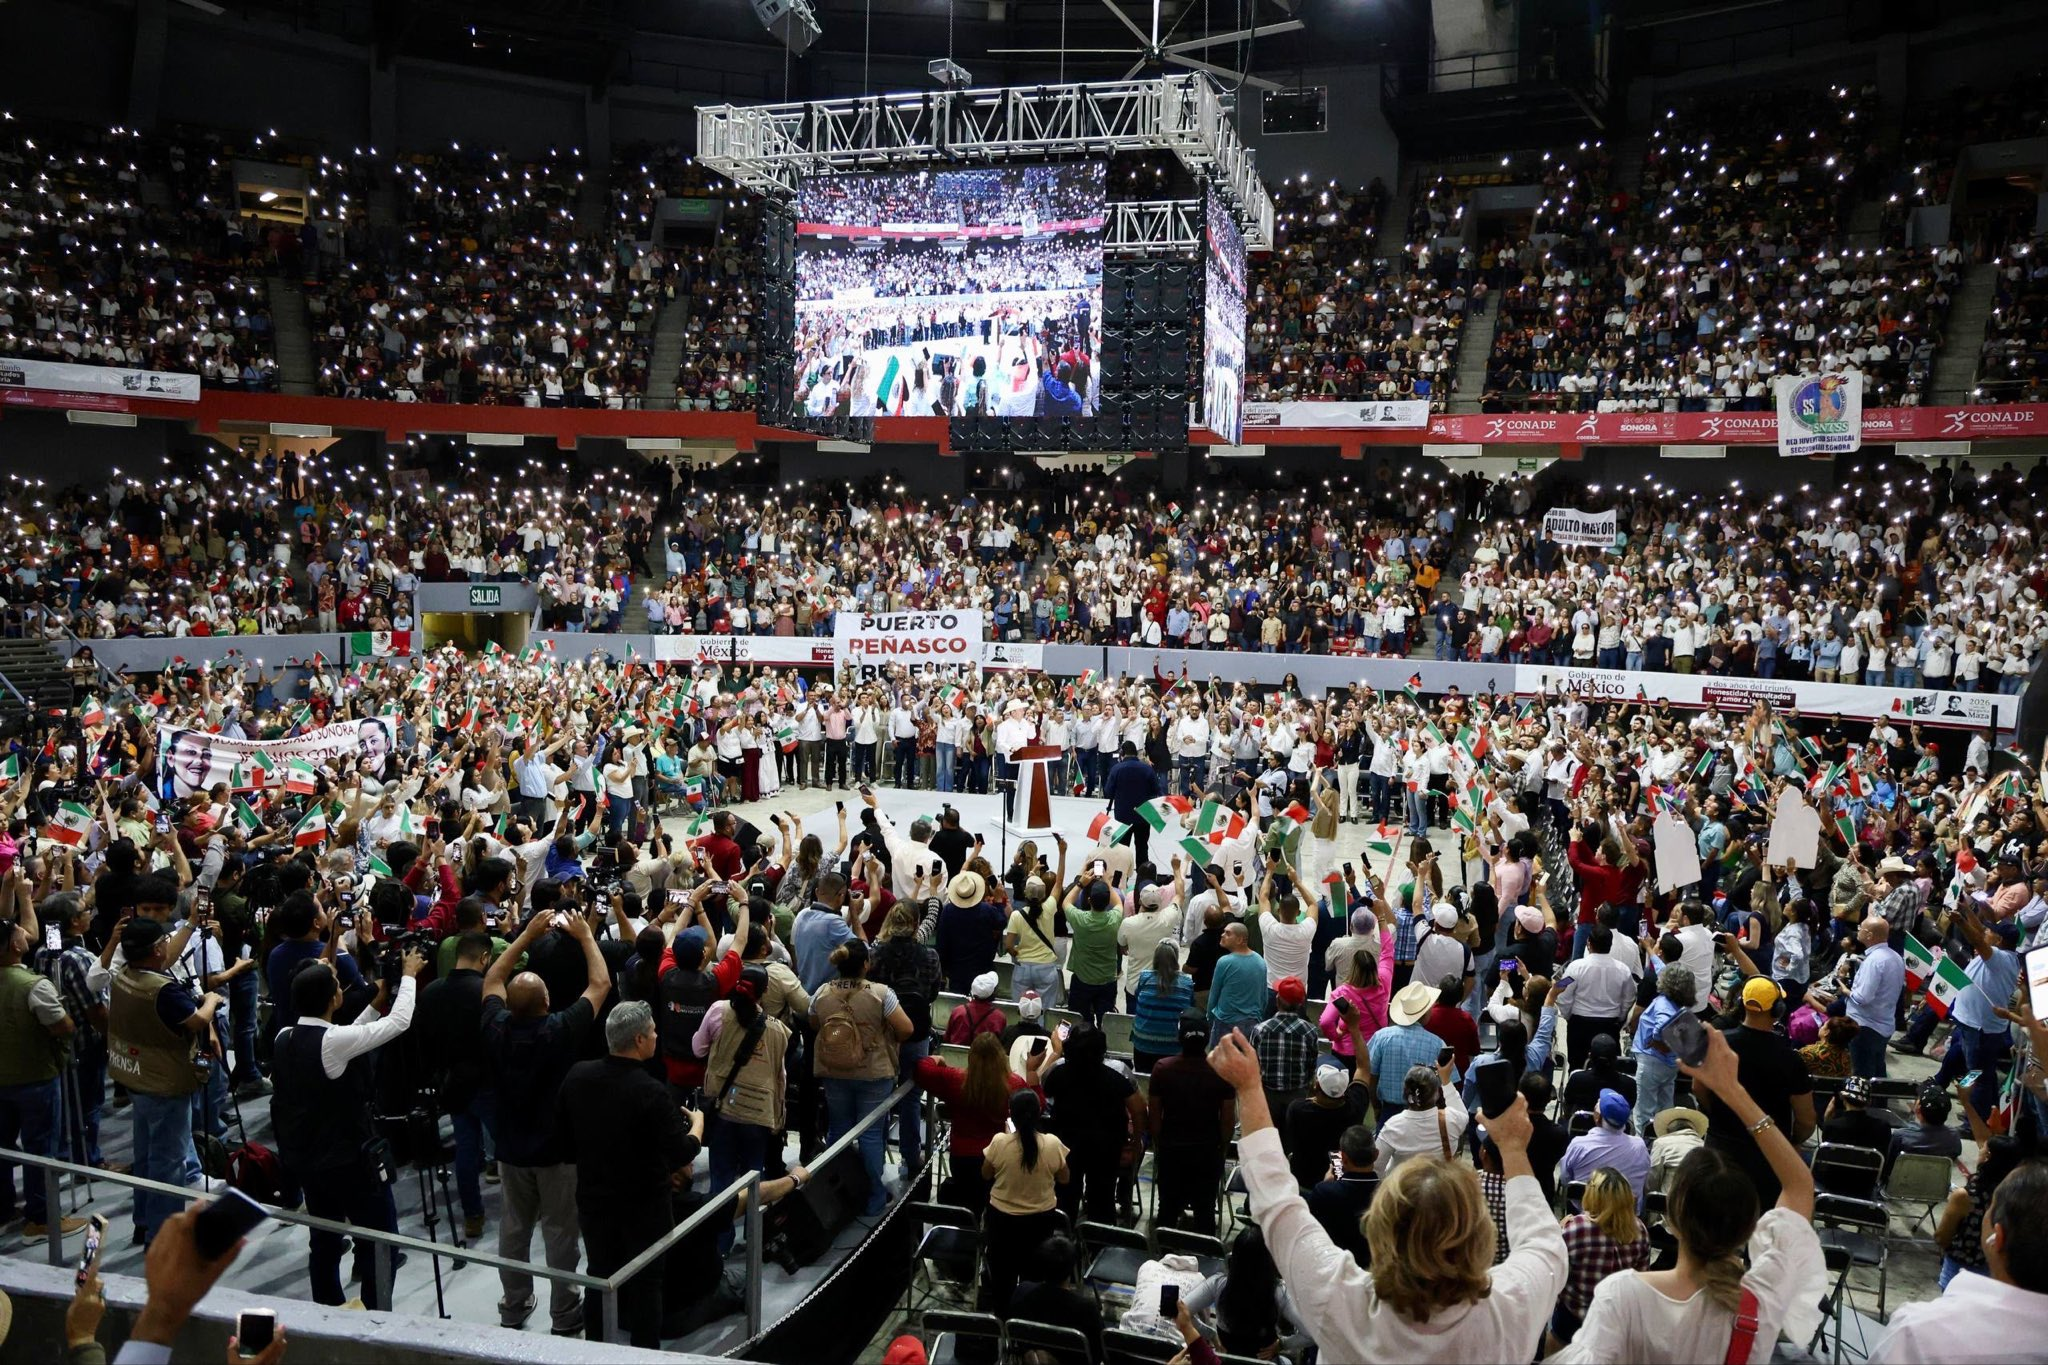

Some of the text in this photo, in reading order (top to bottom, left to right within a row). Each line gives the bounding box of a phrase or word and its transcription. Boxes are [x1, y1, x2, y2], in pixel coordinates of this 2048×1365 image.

[1803, 399, 1815, 416] SS
[1724, 418, 1778, 428] CONADE
[1970, 411, 2034, 423] CONADE
[1507, 420, 1556, 430] CONADE
[1620, 424, 1658, 432] SONORA
[1813, 421, 1849, 434] SNTSS
[1826, 434, 1855, 442] SINDICAL
[1545, 518, 1614, 535] ADULTO MAYOR
[471, 589, 500, 604] SALIDA
[860, 615, 958, 631] PUERTO
[849, 635, 967, 654] PEÑASCO
[700, 645, 748, 658] México
[1568, 671, 1625, 681] Gobierno de
[1568, 679, 1625, 694] México
[1765, 684, 1793, 692] triunfo
[1707, 688, 1791, 700] Honestidad, resultados
[1970, 698, 1990, 706] 2026
